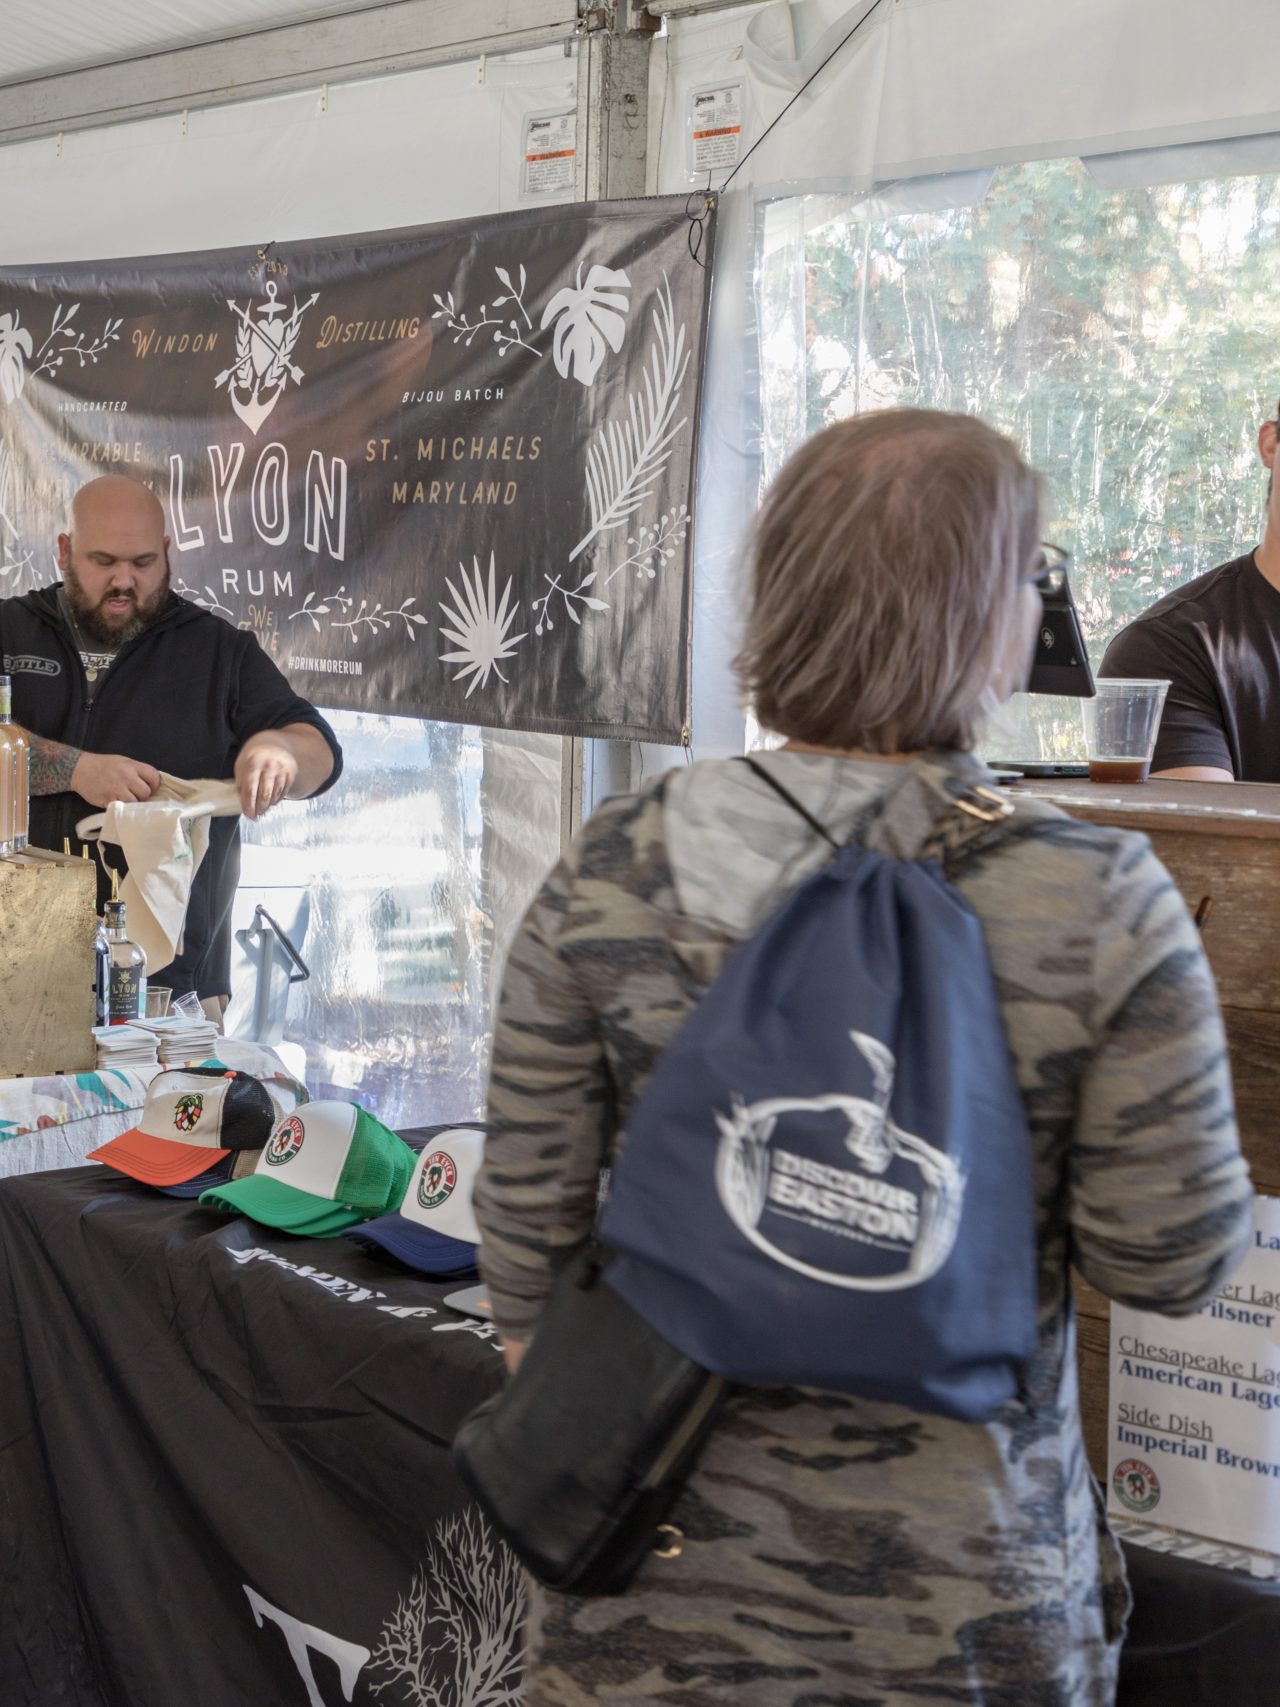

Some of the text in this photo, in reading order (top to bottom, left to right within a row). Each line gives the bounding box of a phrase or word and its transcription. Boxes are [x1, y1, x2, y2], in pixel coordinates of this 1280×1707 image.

[131, 315, 420, 358] WINDON DISTILLING
[58, 401, 128, 412] HANDCRAFTED
[402, 388, 504, 403] BIJOU BATCH
[366, 436, 542, 462] ST. MICHAELS
[170, 442, 347, 561] LYON
[392, 481, 518, 505] MARYLAND
[222, 568, 293, 597] RUM
[248, 604, 274, 628] WE
[3, 658, 55, 673] BATTLE
[288, 656, 363, 676] #DRINKMORERUM
[1119, 1335, 1244, 1377] Chesapeake
[1119, 1359, 1223, 1395] American
[1118, 1403, 1214, 1442] Side Dish
[1117, 1425, 1207, 1461] Imperial
